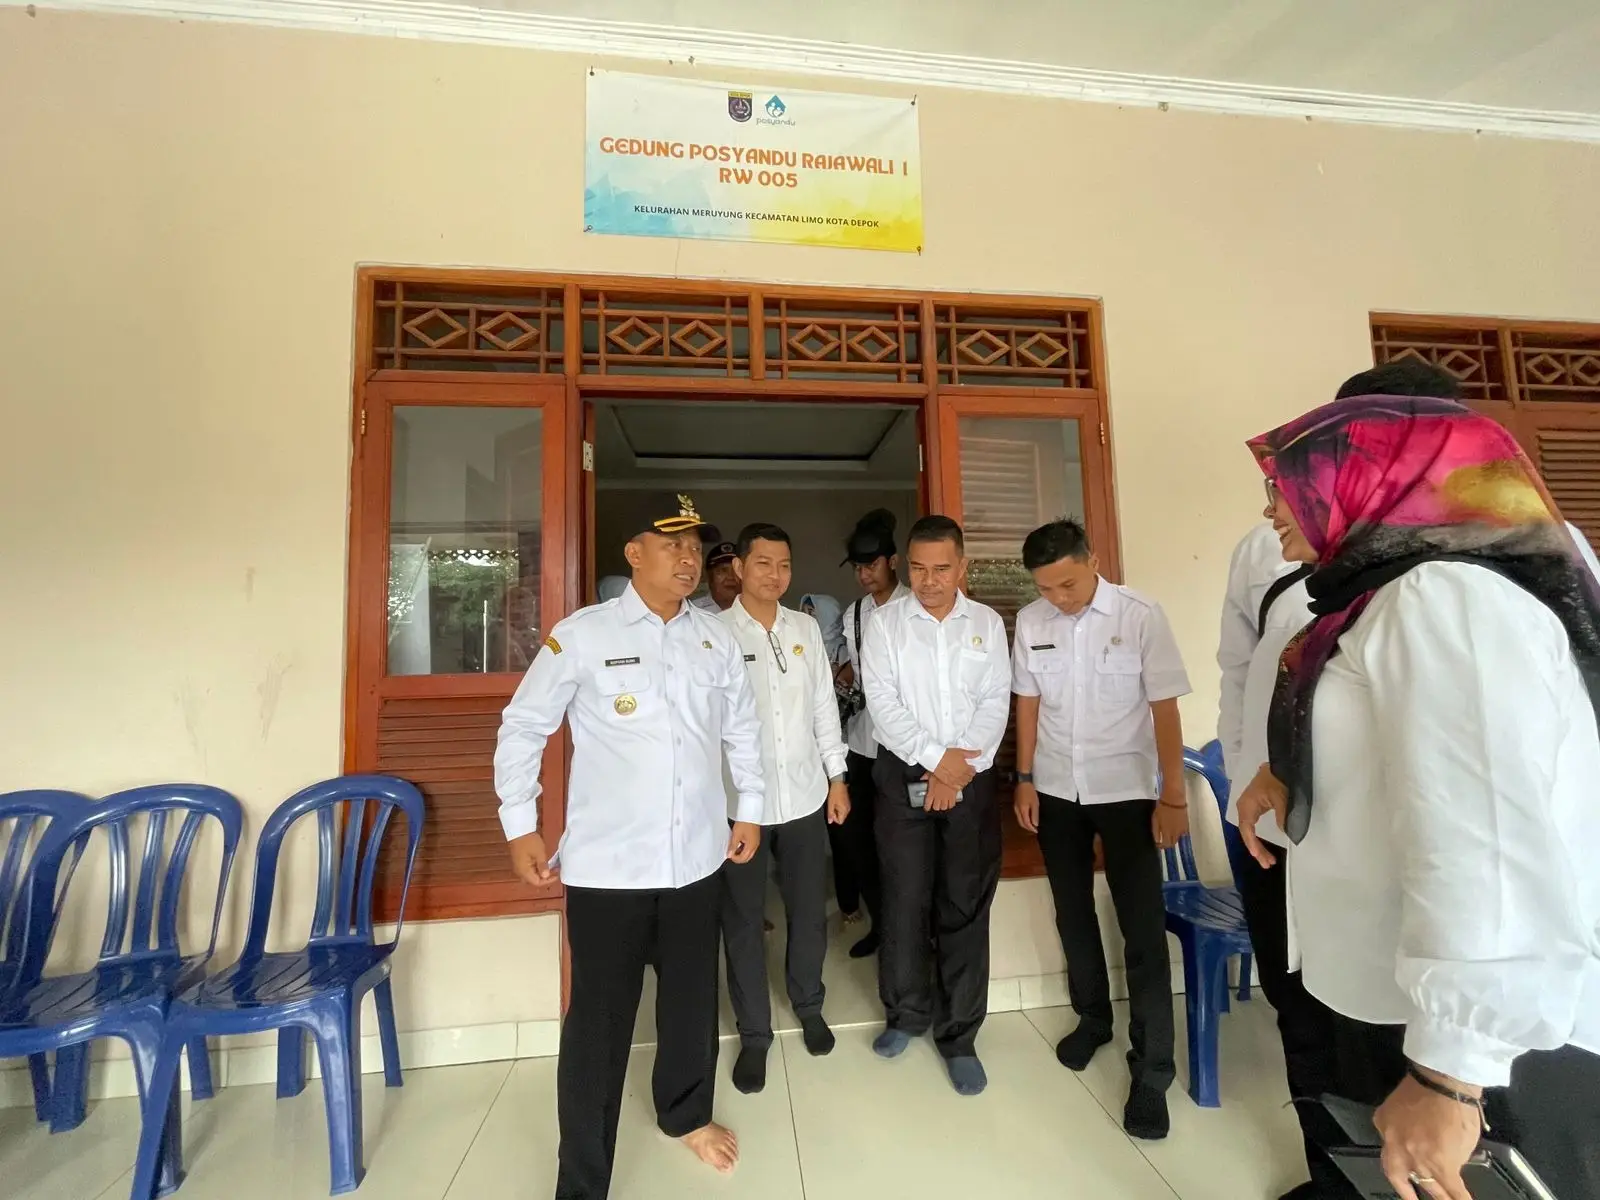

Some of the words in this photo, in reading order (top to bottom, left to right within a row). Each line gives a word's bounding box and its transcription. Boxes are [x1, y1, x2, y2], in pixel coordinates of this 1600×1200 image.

[756, 118, 796, 126] posyandu
[600, 137, 684, 158] GEDUNG
[689, 143, 797, 167] POSYANDU
[719, 167, 753, 185] RW
[757, 171, 798, 188] 005
[634, 205, 690, 216] KELURAHAN
[692, 209, 743, 219] MERUYUNG
[745, 212, 799, 223] KECAMATAN
[801, 216, 824, 225] LIMO
[826, 218, 849, 226] KOTA
[851, 219, 880, 228] DEPOK
